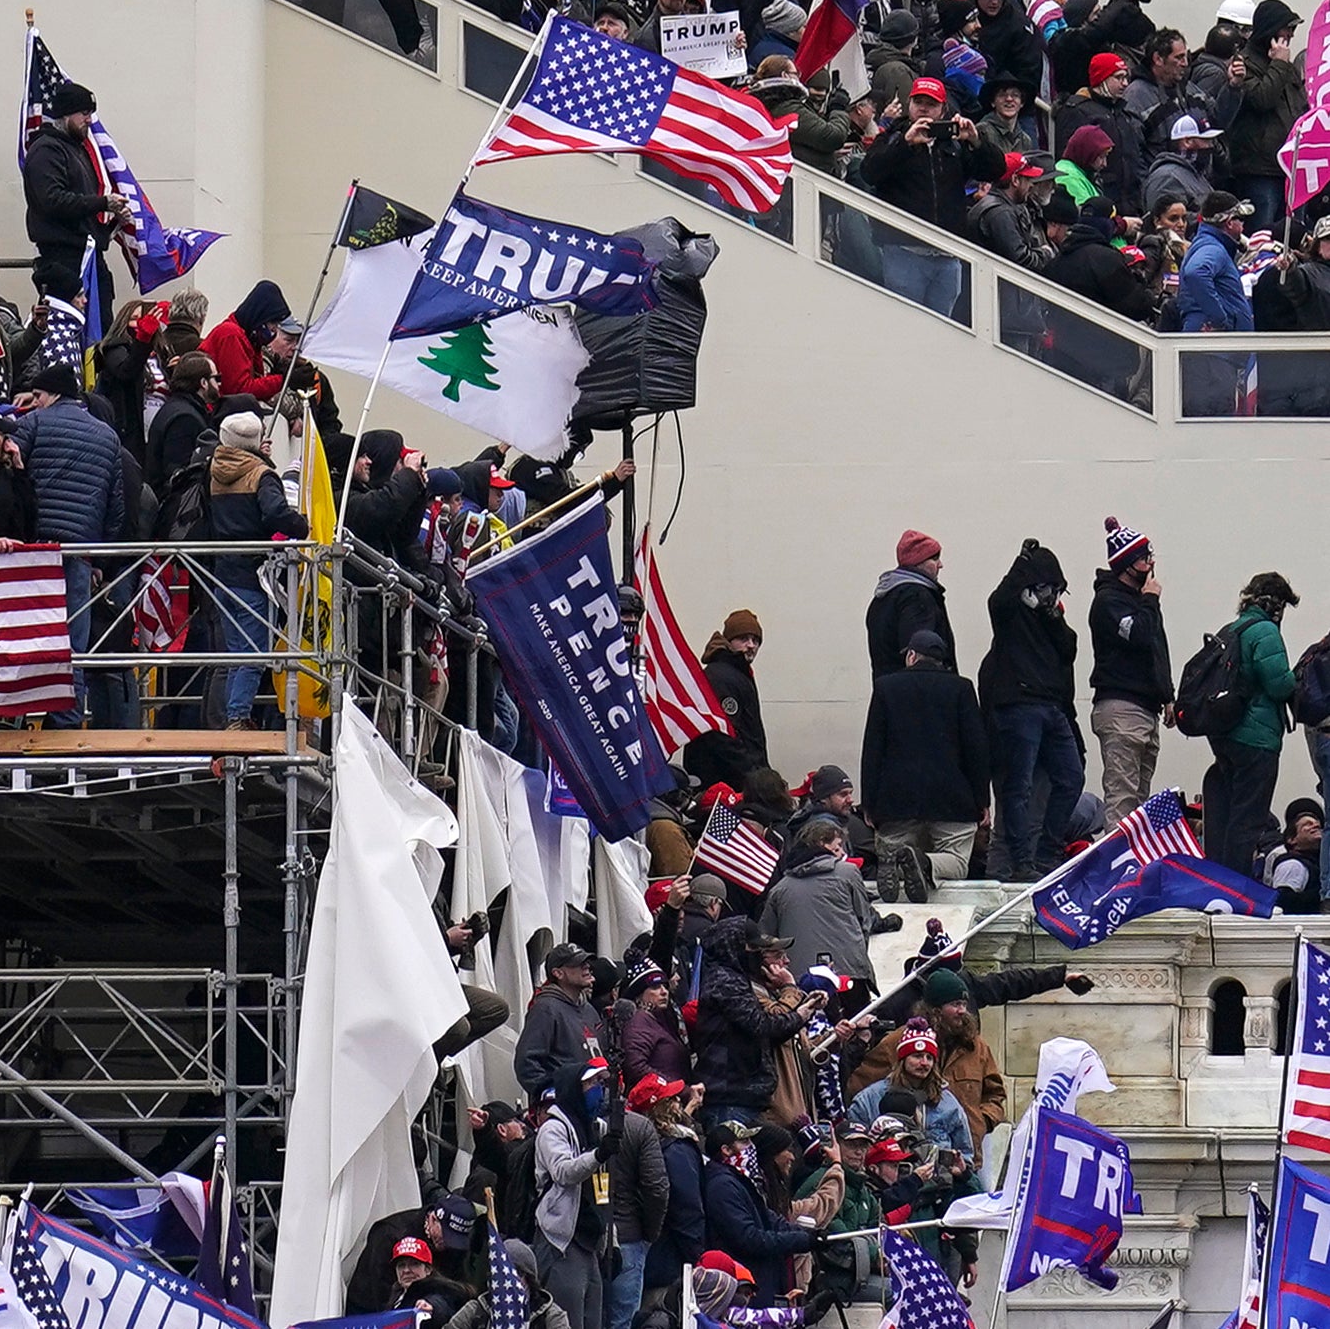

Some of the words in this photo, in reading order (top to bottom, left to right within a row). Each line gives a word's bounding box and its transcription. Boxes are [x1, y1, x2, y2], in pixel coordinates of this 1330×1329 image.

[663, 20, 739, 42] TRUMP
[421, 259, 467, 288] KEEP
[529, 603, 551, 644] MAKE
[548, 641, 580, 695] AMERICA
[578, 695, 605, 735] GREAT
[600, 735, 629, 781] AGAIN!
[549, 594, 643, 766] PENCE
